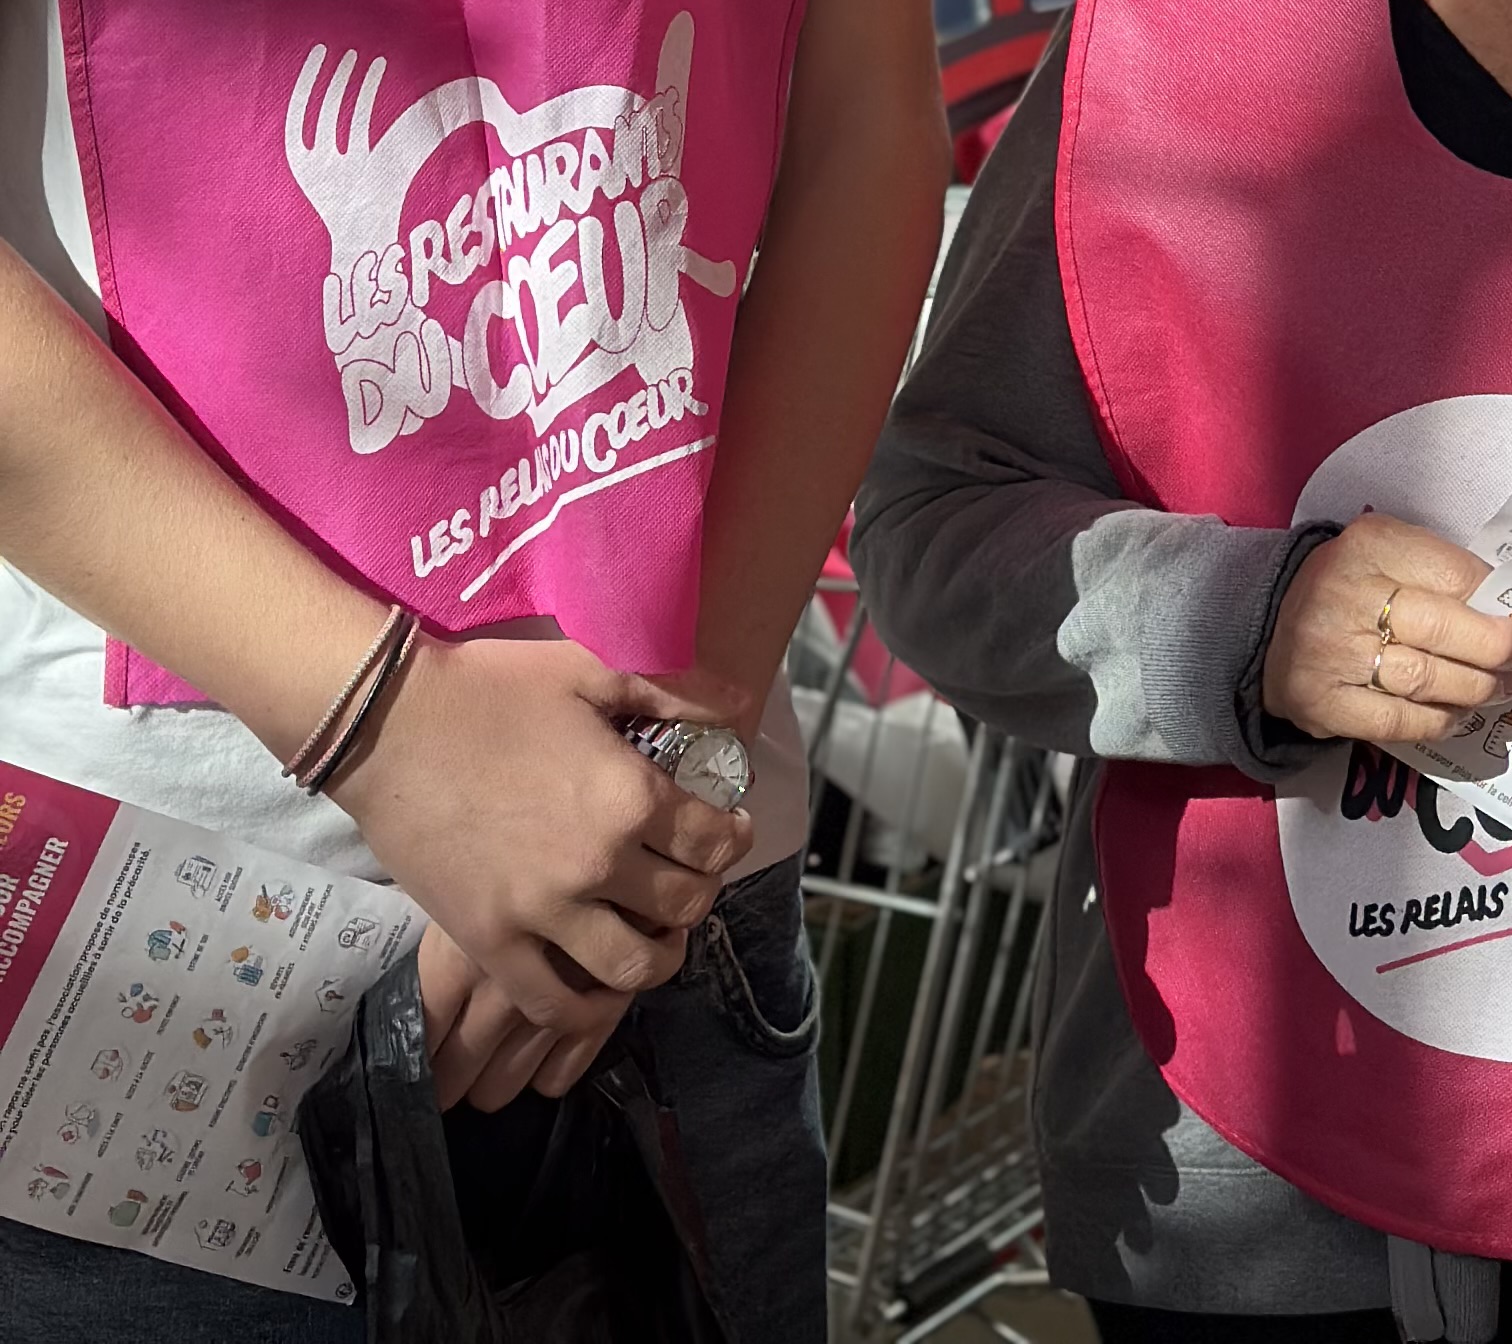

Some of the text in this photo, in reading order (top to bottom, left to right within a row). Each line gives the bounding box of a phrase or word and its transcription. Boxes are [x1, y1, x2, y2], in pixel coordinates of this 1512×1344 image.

[410, 505, 475, 579] LES
[1350, 902, 1396, 937] LES
[1400, 882, 1508, 935] RELAIS
